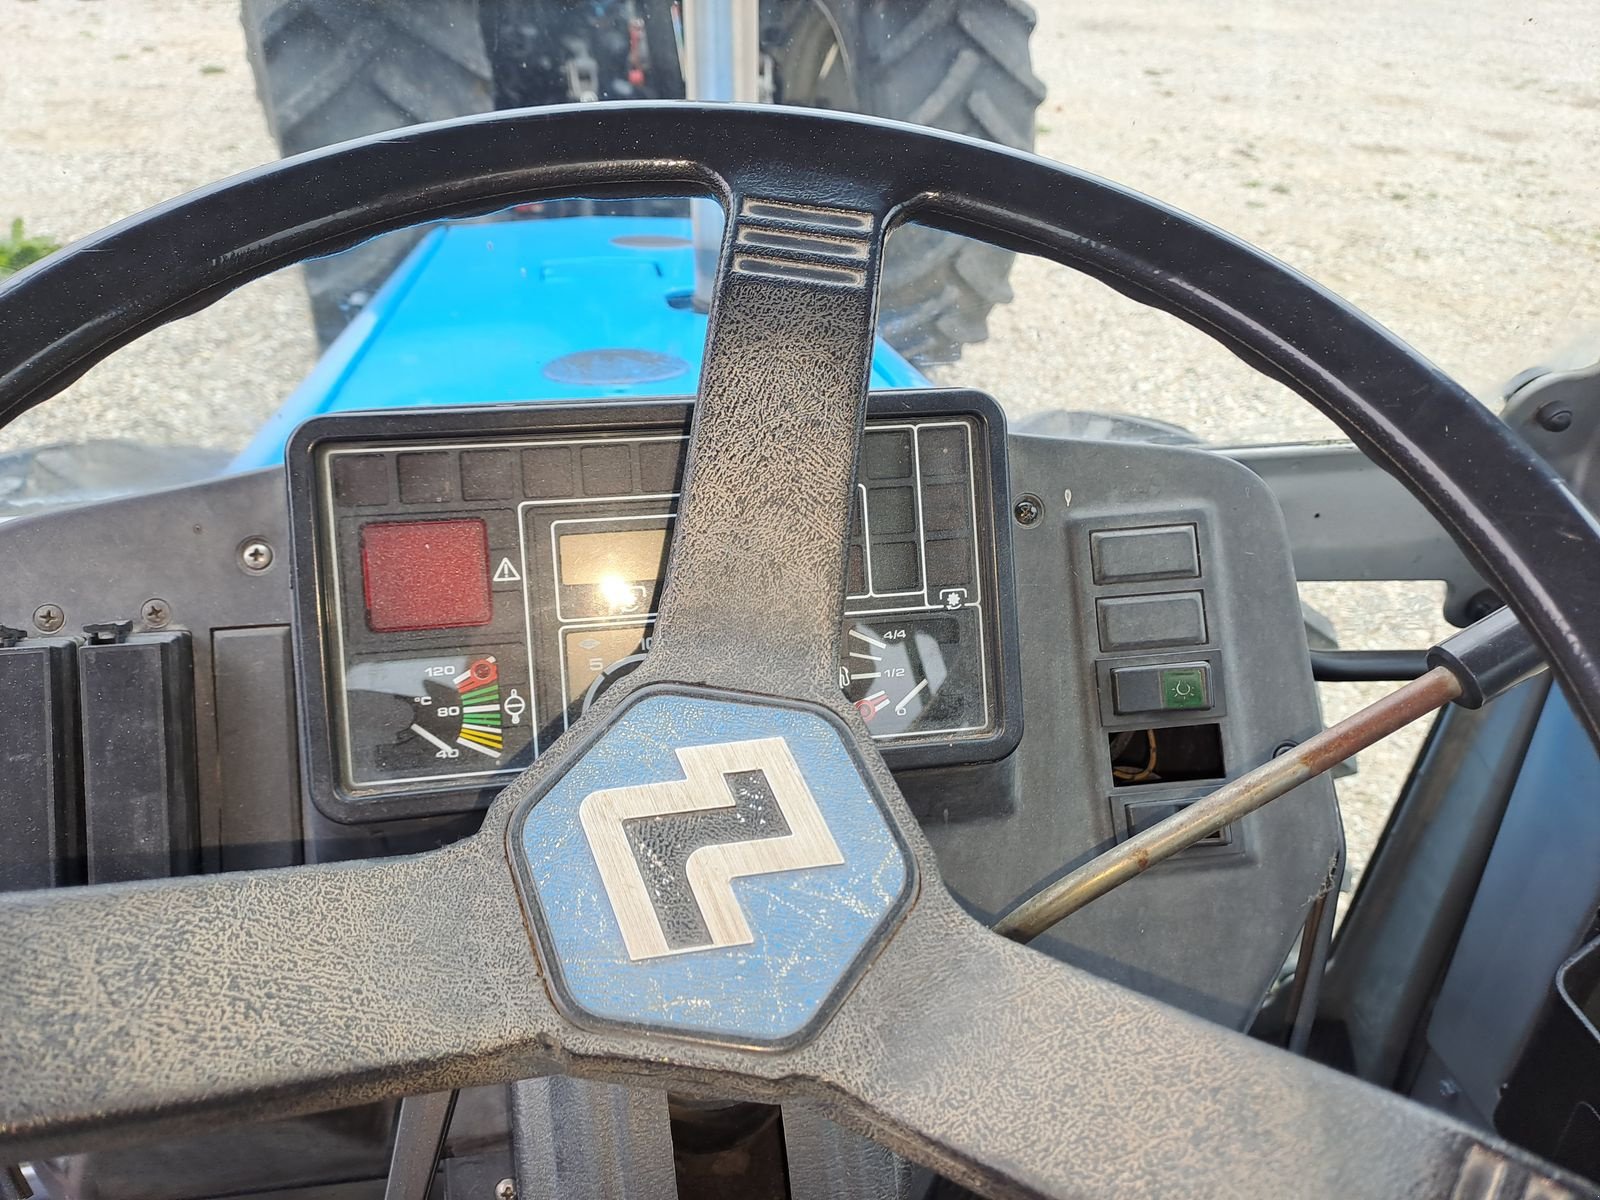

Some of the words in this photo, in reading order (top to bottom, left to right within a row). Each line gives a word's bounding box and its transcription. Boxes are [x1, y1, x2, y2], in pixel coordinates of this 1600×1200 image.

[883, 629, 907, 640] 4/4
[589, 657, 603, 671] 5
[424, 665, 456, 677] 120
[883, 668, 905, 678] 1/2
[437, 706, 460, 717] 80
[435, 748, 460, 760] 40
